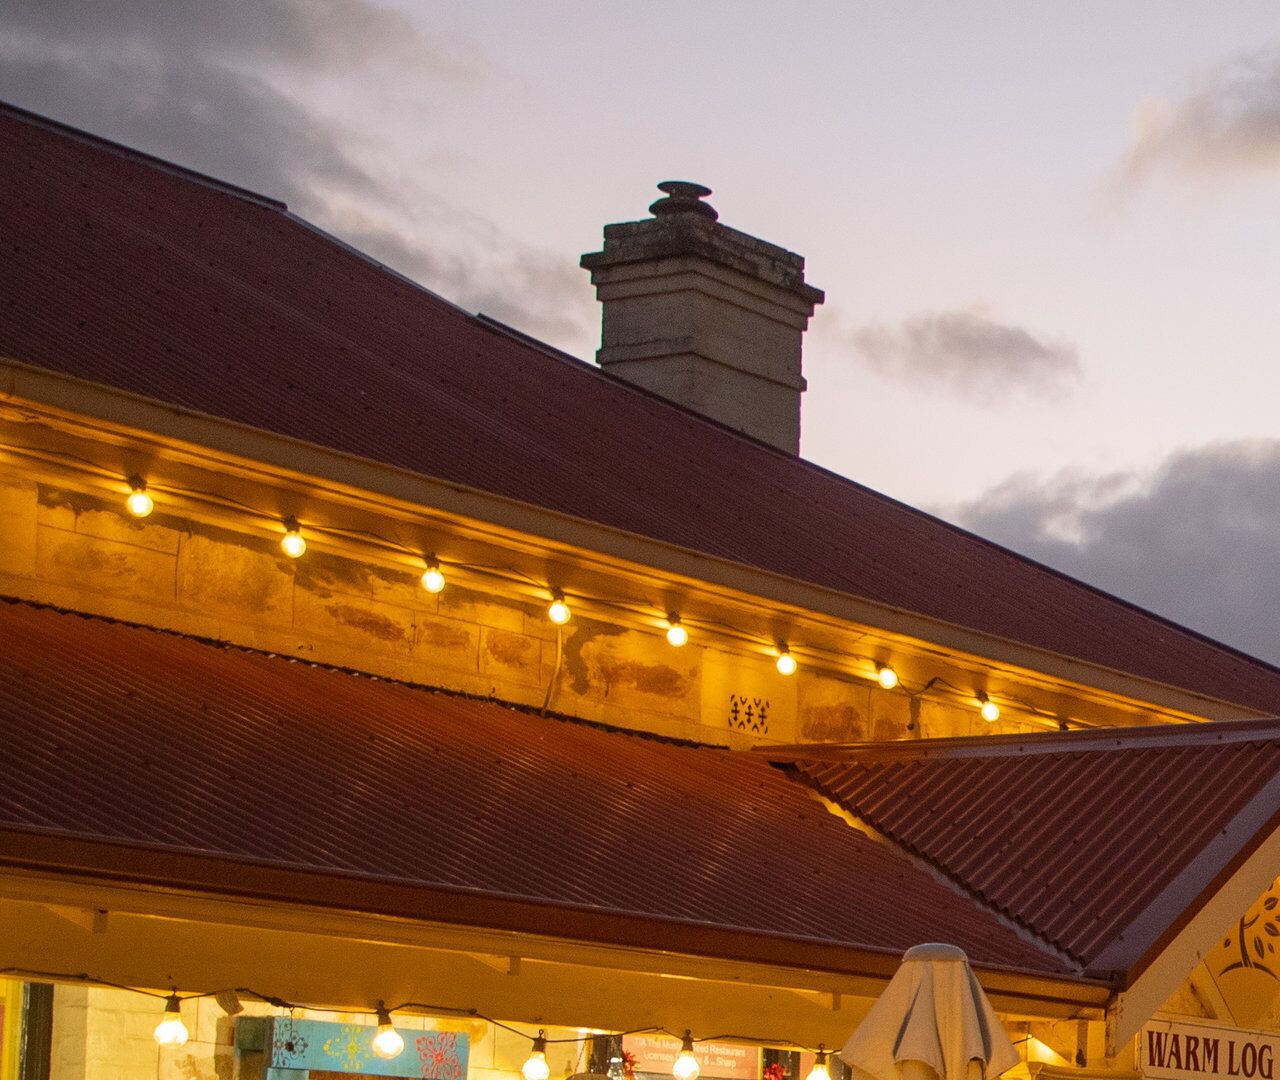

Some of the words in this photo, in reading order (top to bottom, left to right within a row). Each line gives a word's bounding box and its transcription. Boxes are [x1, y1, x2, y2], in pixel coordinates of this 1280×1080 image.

[710, 1044, 746, 1057] Restaurant
[1147, 1031, 1220, 1073] WARM
[1227, 1040, 1273, 1080] LOG
